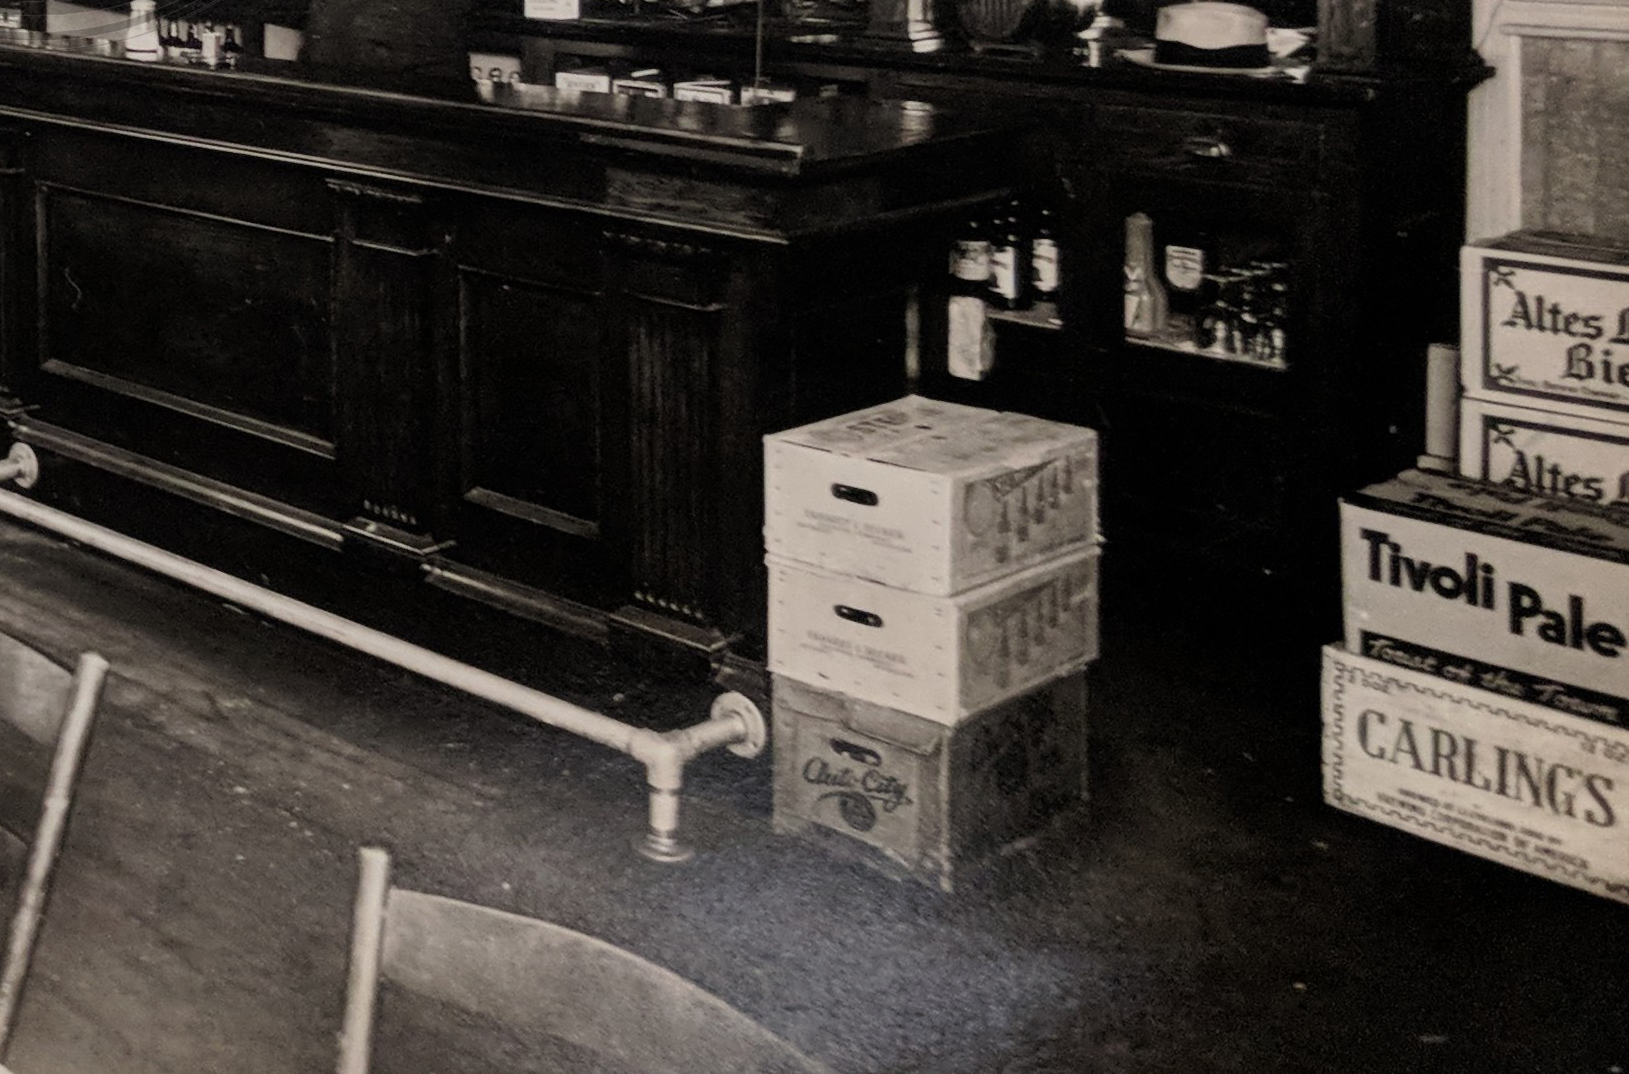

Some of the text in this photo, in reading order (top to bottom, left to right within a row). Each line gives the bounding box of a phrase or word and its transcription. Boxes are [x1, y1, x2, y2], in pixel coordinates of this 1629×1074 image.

[1501, 290, 1605, 341] Altes
[1501, 450, 1605, 503] Altes
[1360, 528, 1628, 659] Tivoli Pale
